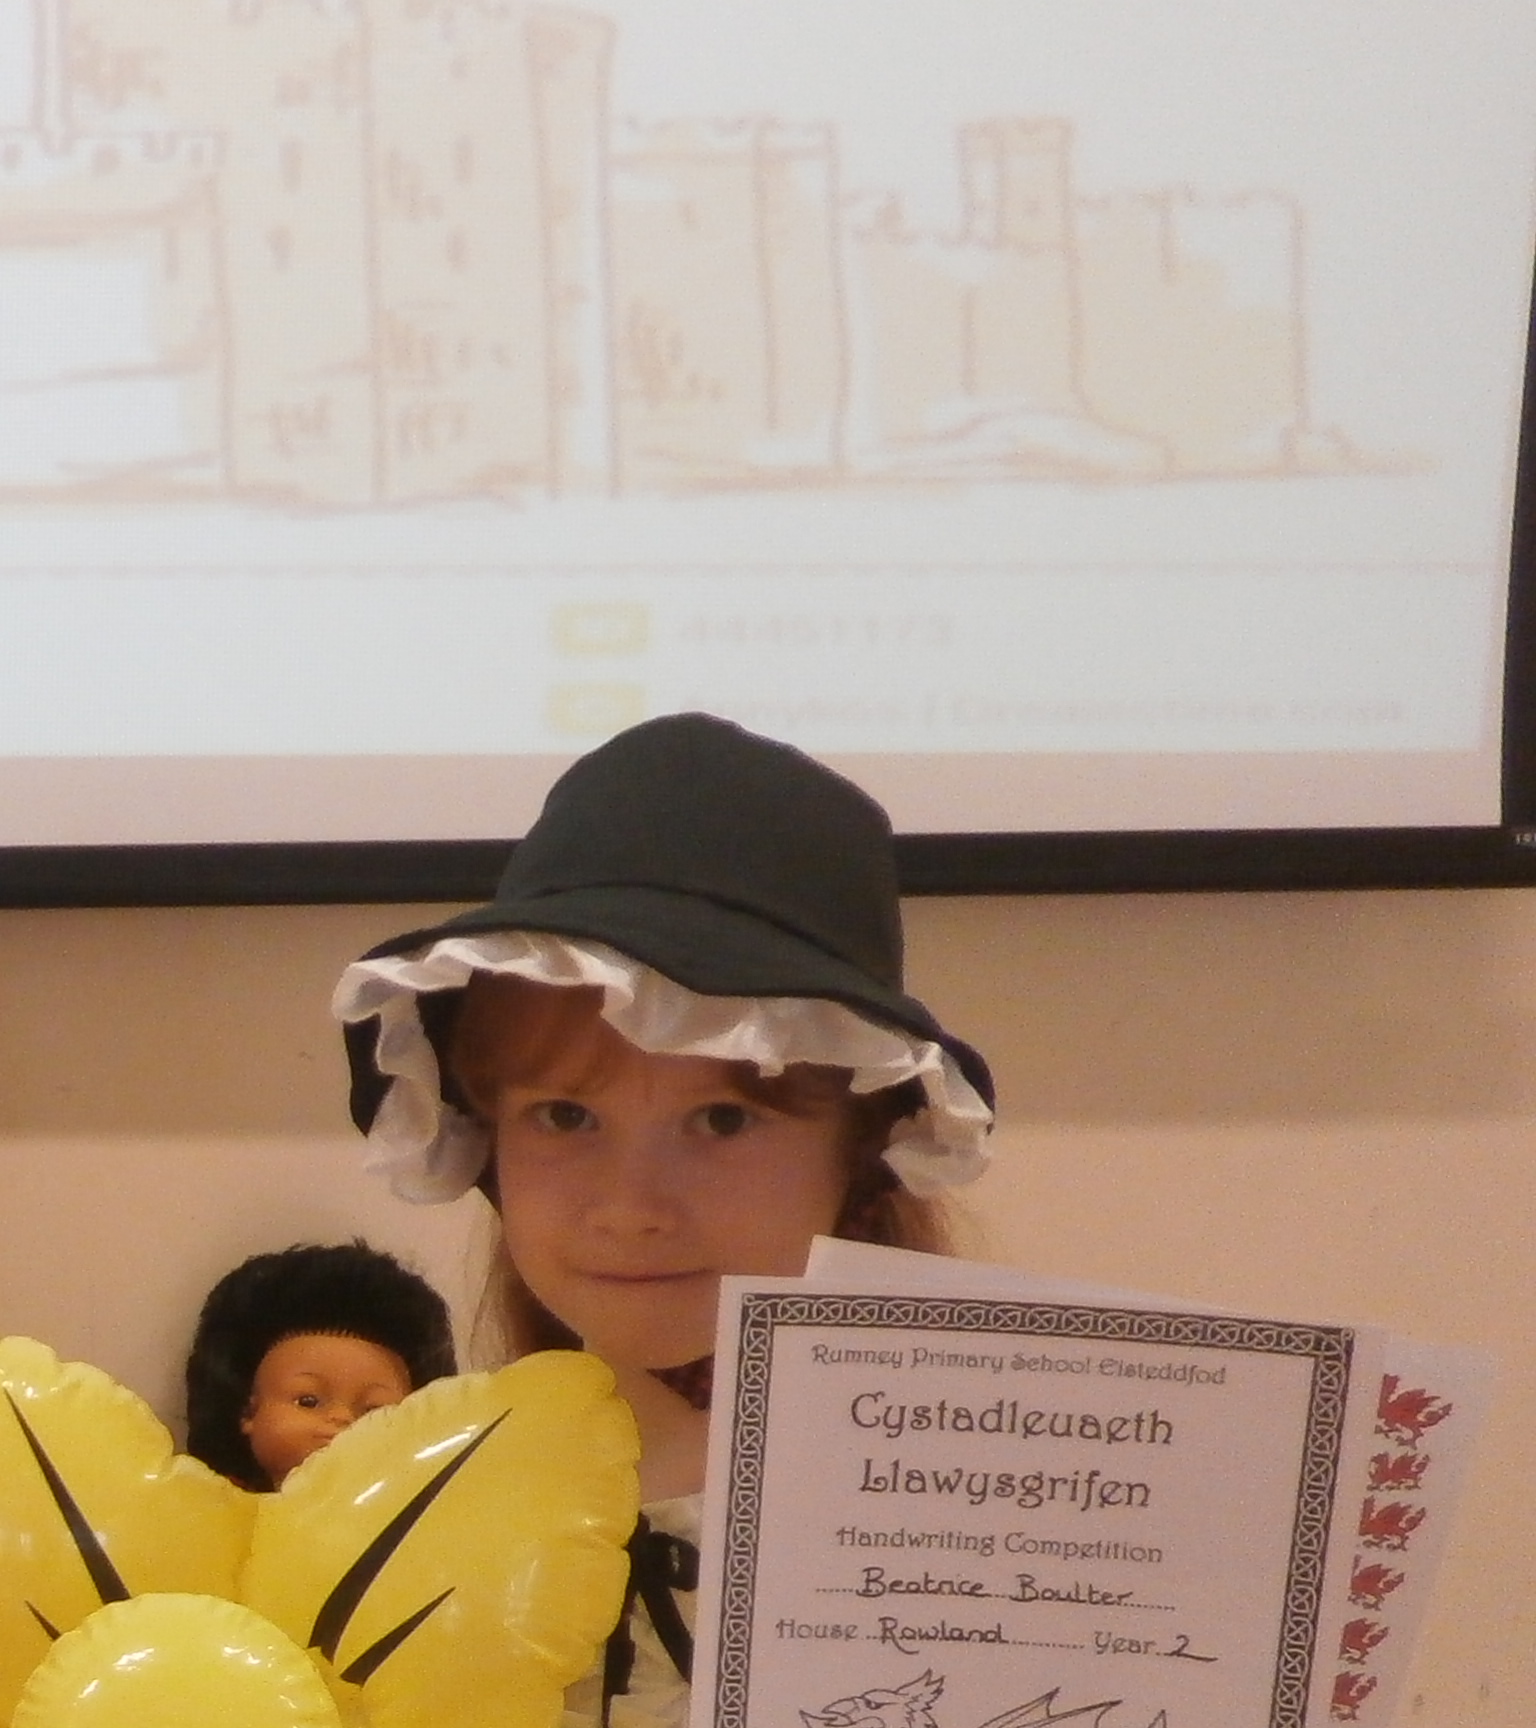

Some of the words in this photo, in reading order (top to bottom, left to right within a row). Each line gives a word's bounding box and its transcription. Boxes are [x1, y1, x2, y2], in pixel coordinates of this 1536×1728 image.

[811, 1343, 903, 1367] Rumney
[910, 1346, 1004, 1374] Primary
[1009, 1352, 1091, 1375] School
[1098, 1357, 1228, 1387] Eisteddfod
[850, 1390, 1175, 1446] Cystadleuaeth
[858, 1457, 1152, 1512] Llawysgrifen
[835, 1525, 996, 1558] Handwriting
[1003, 1530, 1164, 1564] Competition
[855, 1566, 992, 1599] Beatrice
[1008, 1572, 1134, 1608] Boulter
[776, 1617, 858, 1642] House
[878, 1616, 1010, 1656] Rowland
[1093, 1629, 1157, 1656] Year
[1168, 1634, 1219, 1662] 2
